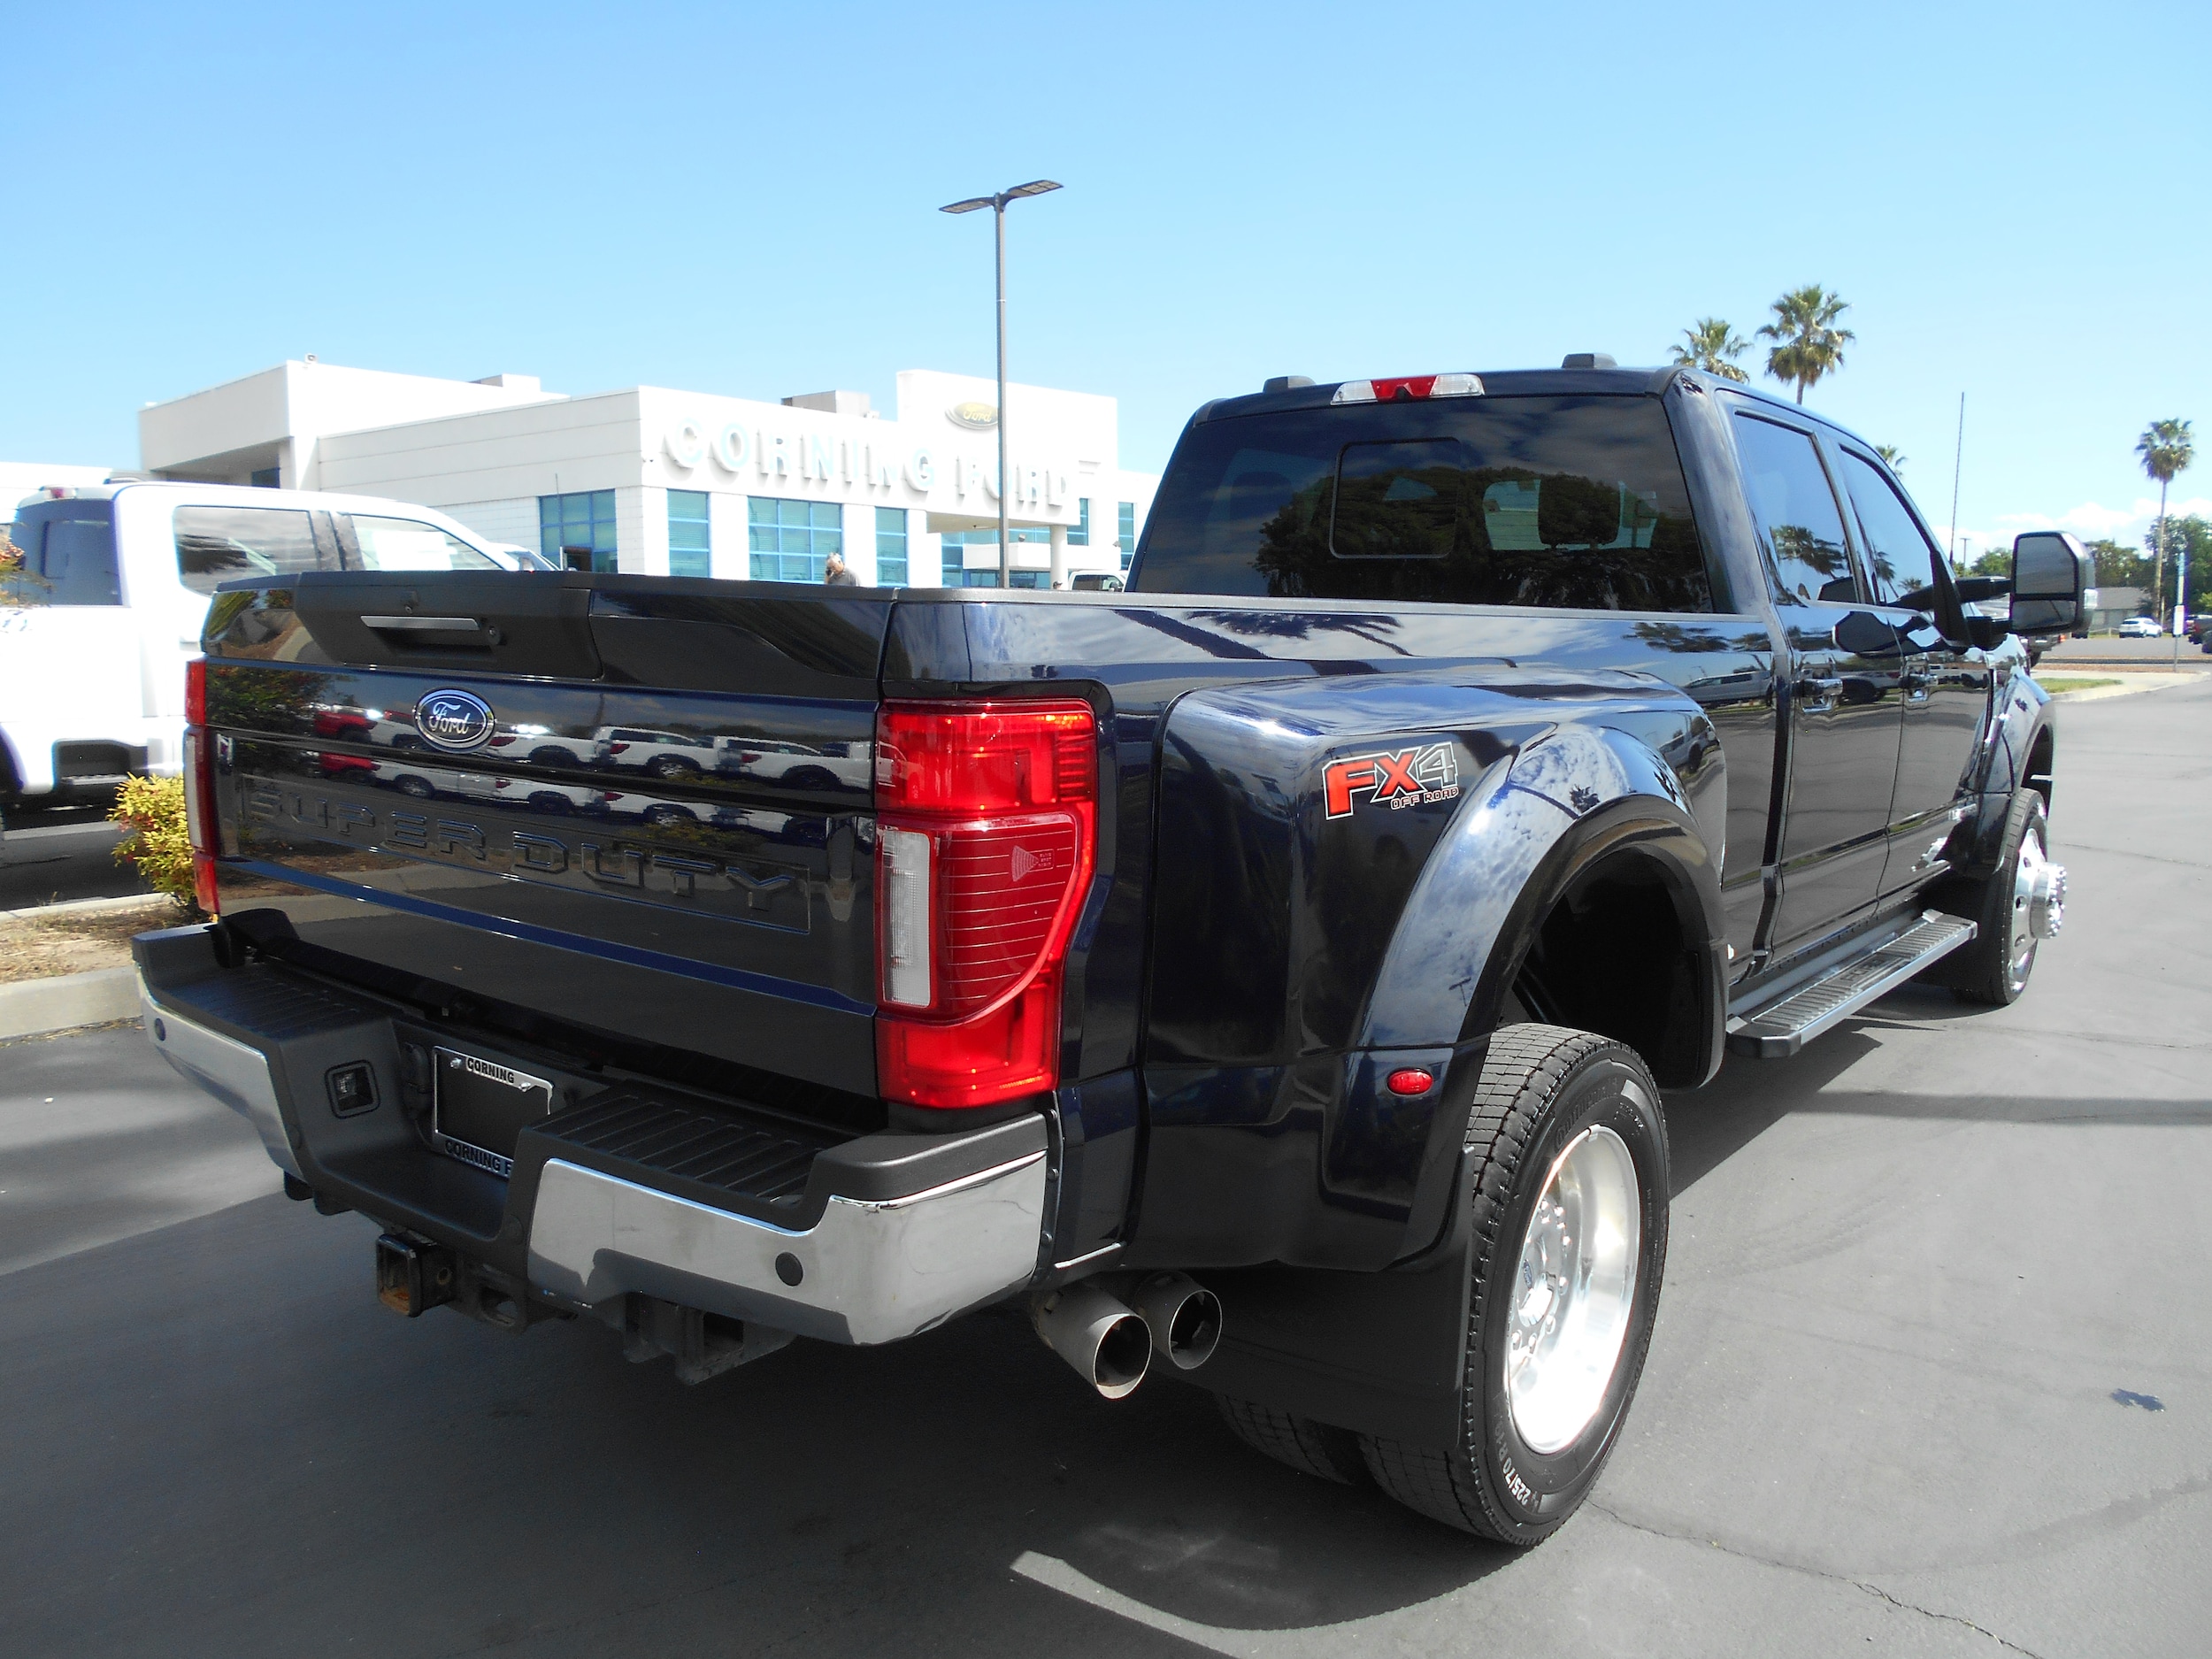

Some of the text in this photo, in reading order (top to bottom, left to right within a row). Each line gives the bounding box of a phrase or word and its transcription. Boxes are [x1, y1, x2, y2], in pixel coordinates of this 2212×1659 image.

[963, 404, 992, 422] Ford
[664, 418, 935, 494] CORNING
[429, 701, 471, 734] Ford
[1322, 741, 1458, 820] FX4
[1390, 787, 1459, 810] OFF ROAD
[244, 788, 795, 911] SUPER DUTY
[467, 1057, 515, 1084] CORNING
[445, 1140, 501, 1172] CORNING
